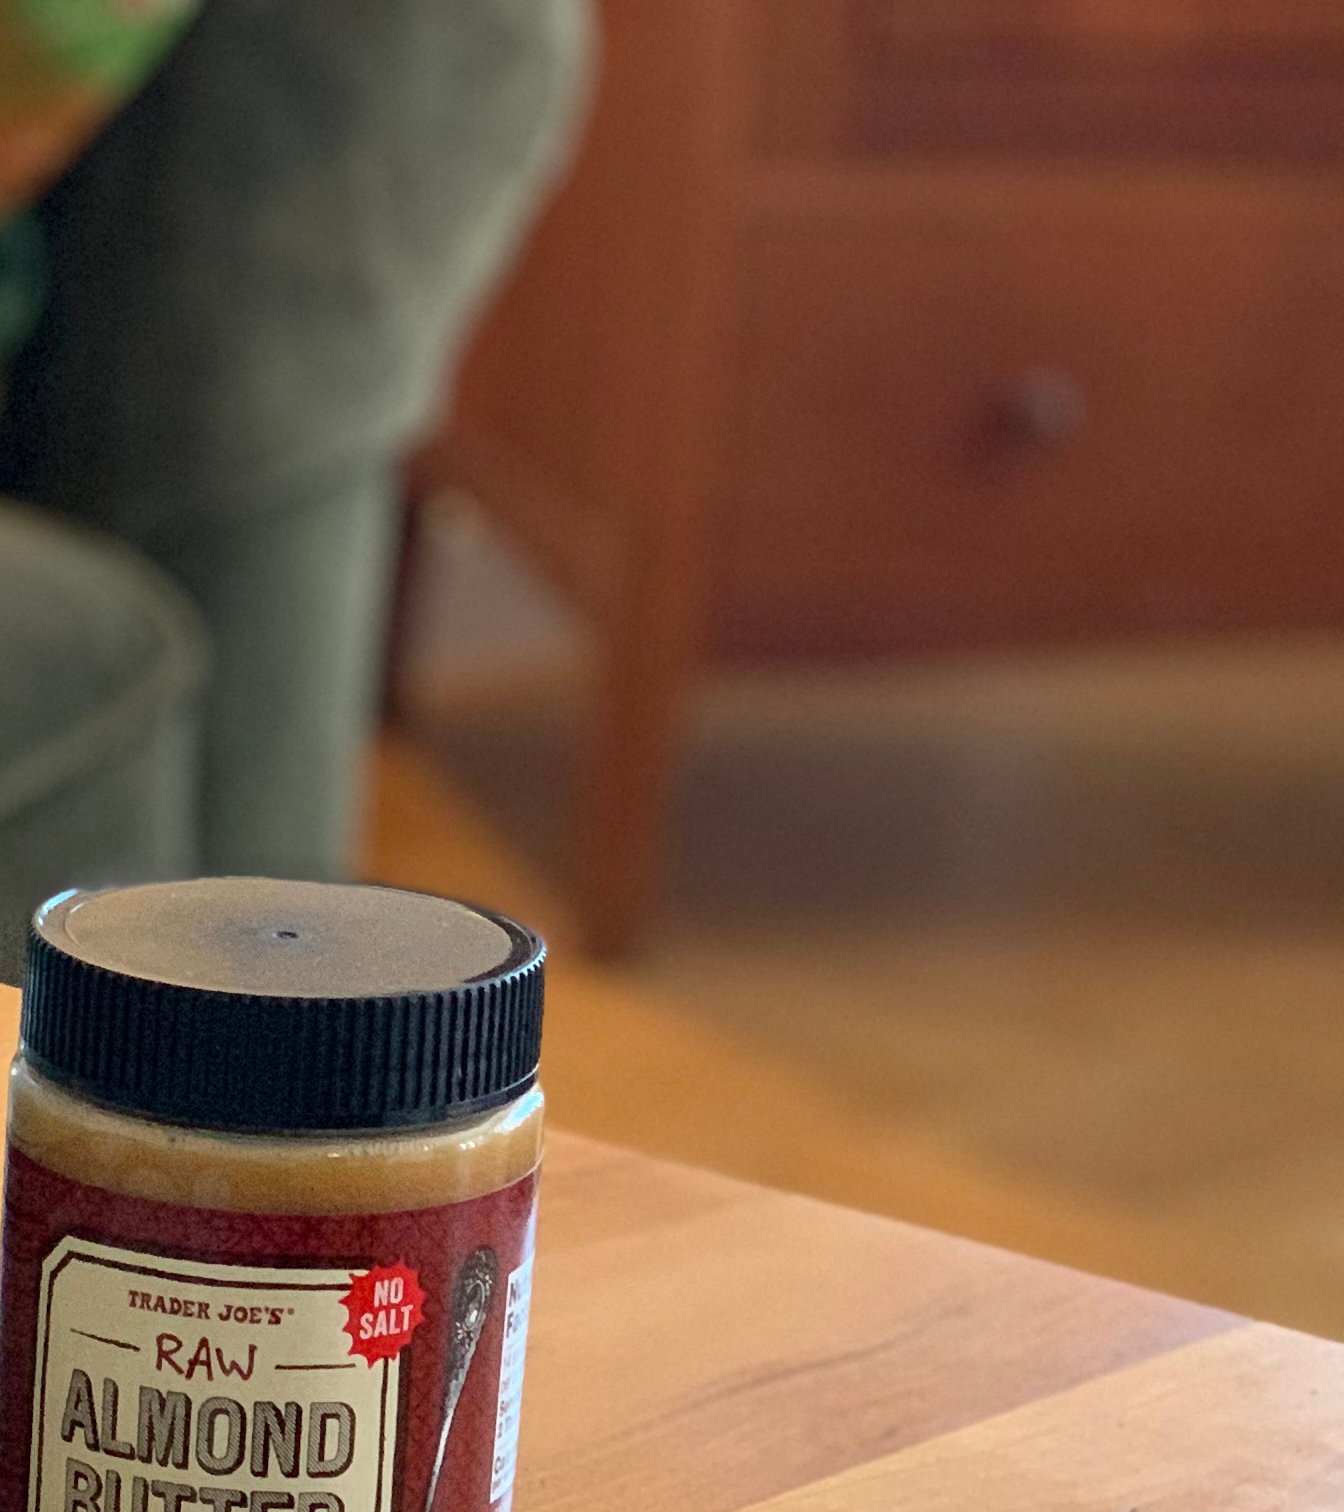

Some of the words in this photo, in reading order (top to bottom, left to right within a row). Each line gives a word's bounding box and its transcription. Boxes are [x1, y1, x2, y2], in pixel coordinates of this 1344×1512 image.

[129, 1290, 211, 1320] TRADER
[217, 1304, 283, 1325] JOE'S
[374, 1277, 404, 1306] NO
[360, 1304, 413, 1340] SALT
[155, 1334, 258, 1381] RAW
[61, 1368, 357, 1479] ALMOND
